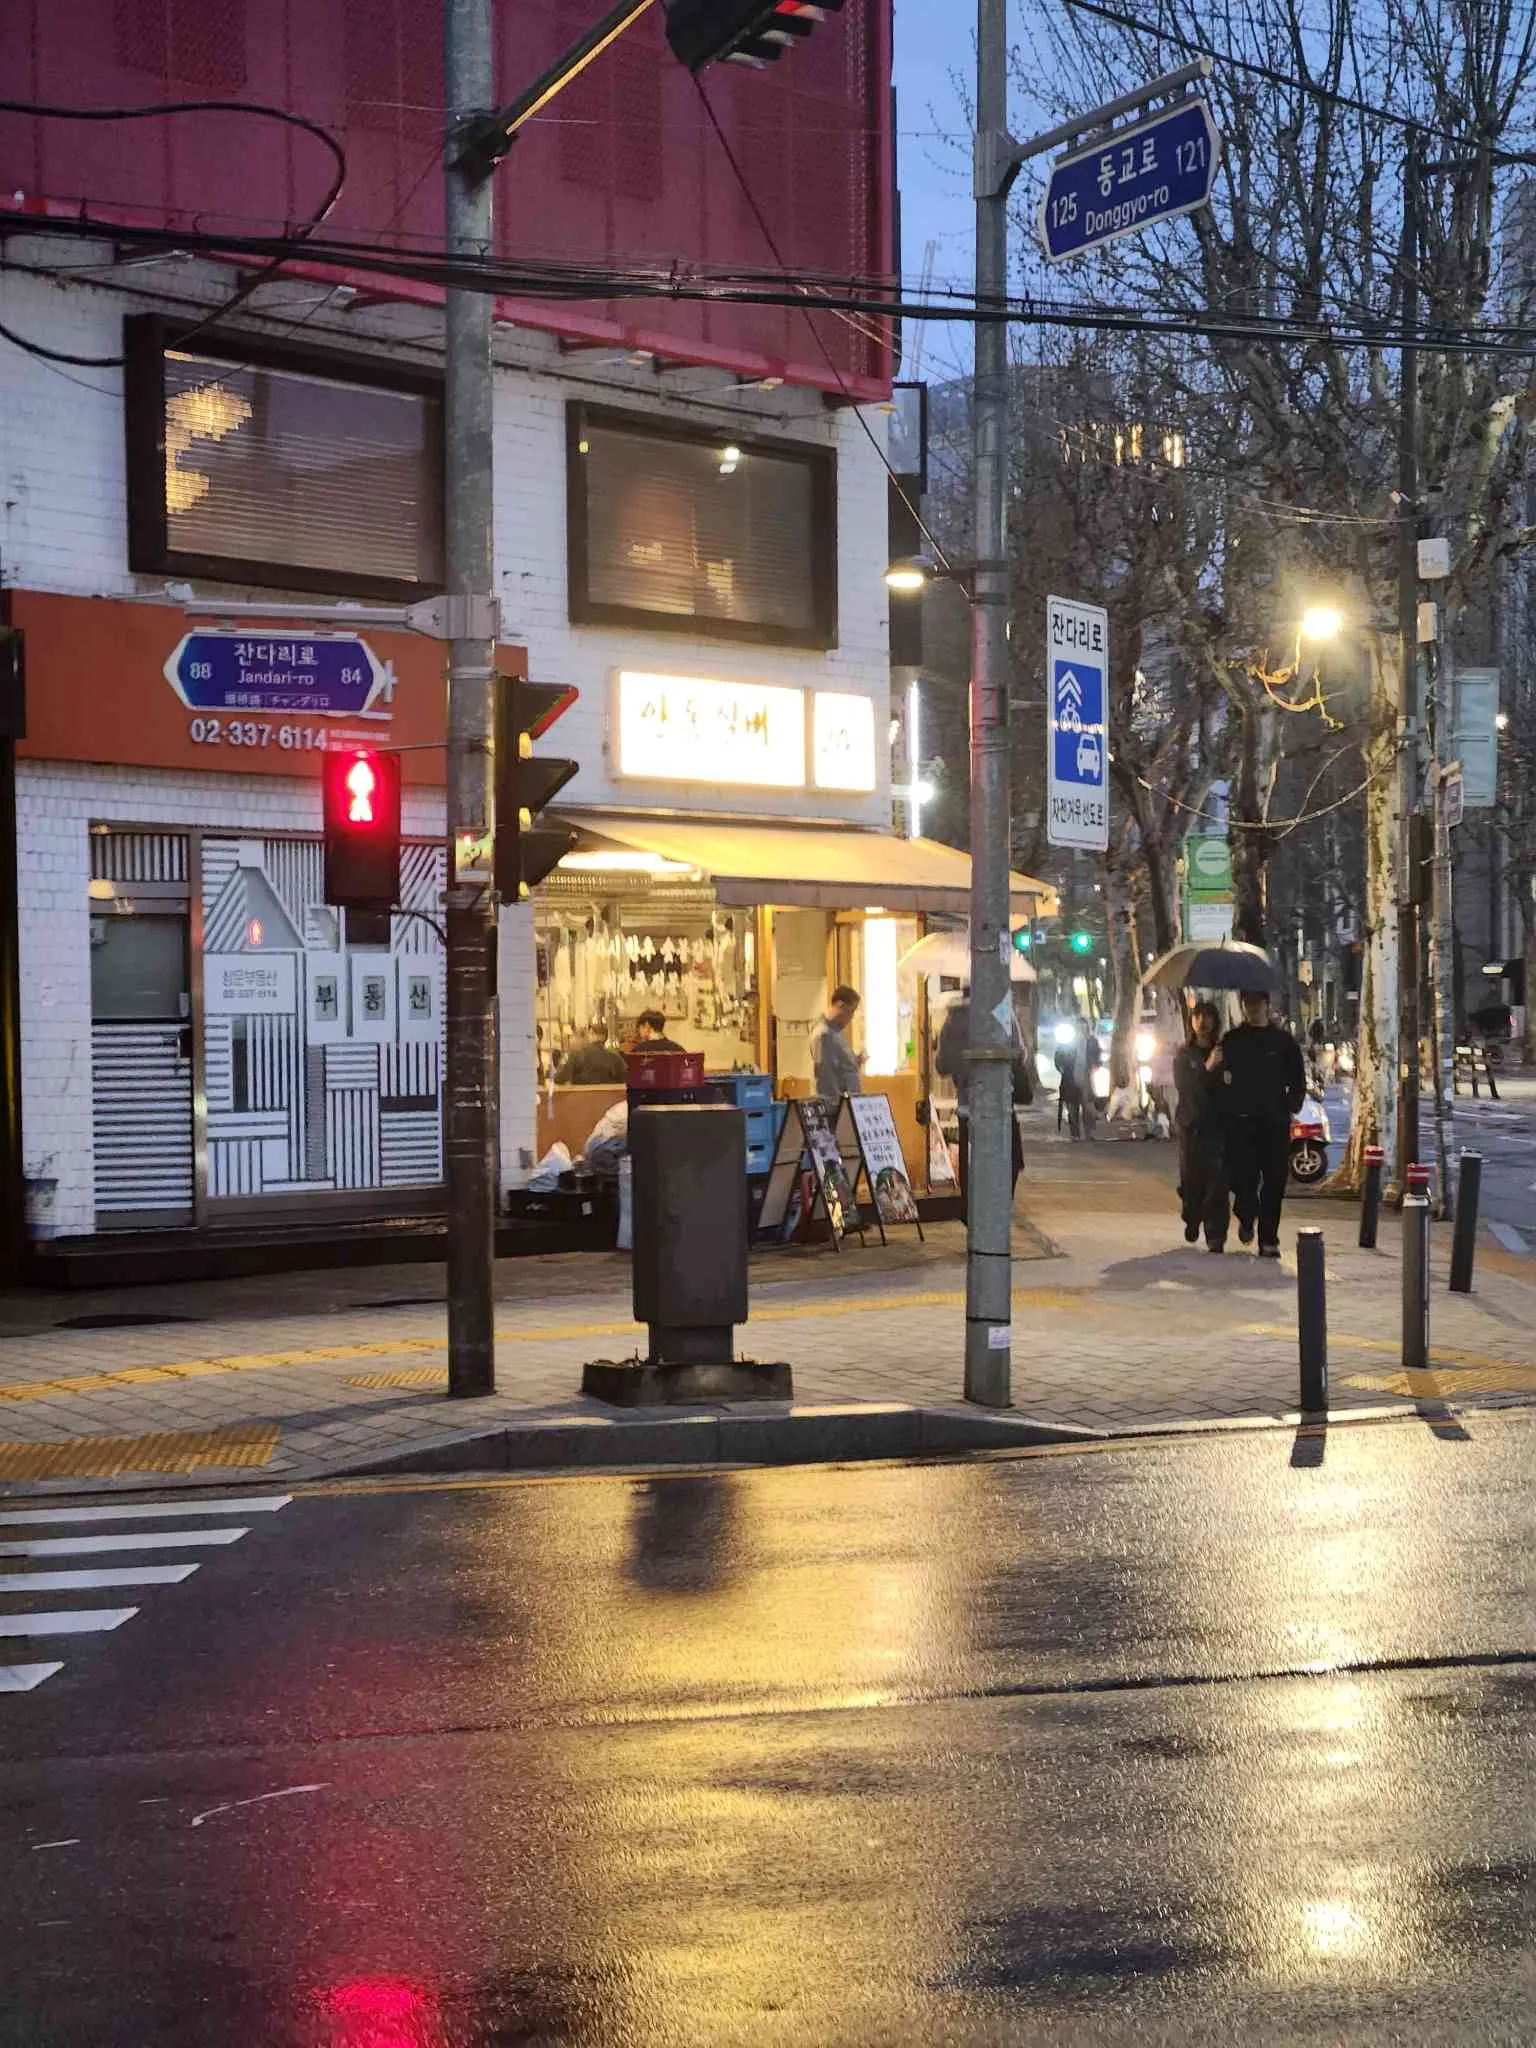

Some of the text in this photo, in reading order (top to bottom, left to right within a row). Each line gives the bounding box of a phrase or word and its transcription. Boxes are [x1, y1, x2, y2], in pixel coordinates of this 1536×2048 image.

[1097, 137, 1158, 197] 동교로
[1175, 137, 1205, 175] 121
[1051, 191, 1078, 229] 125
[1085, 184, 1169, 236] Donggyo-ro
[1052, 612, 1103, 652] 잔다리로
[234, 642, 319, 666] 잔다리로
[189, 662, 212, 680] 88
[238, 669, 315, 686] Jandari-ro
[341, 667, 362, 685] 84
[1052, 797, 1104, 827] 자전거우선도로
[315, 983, 428, 1012] 부 동 산
